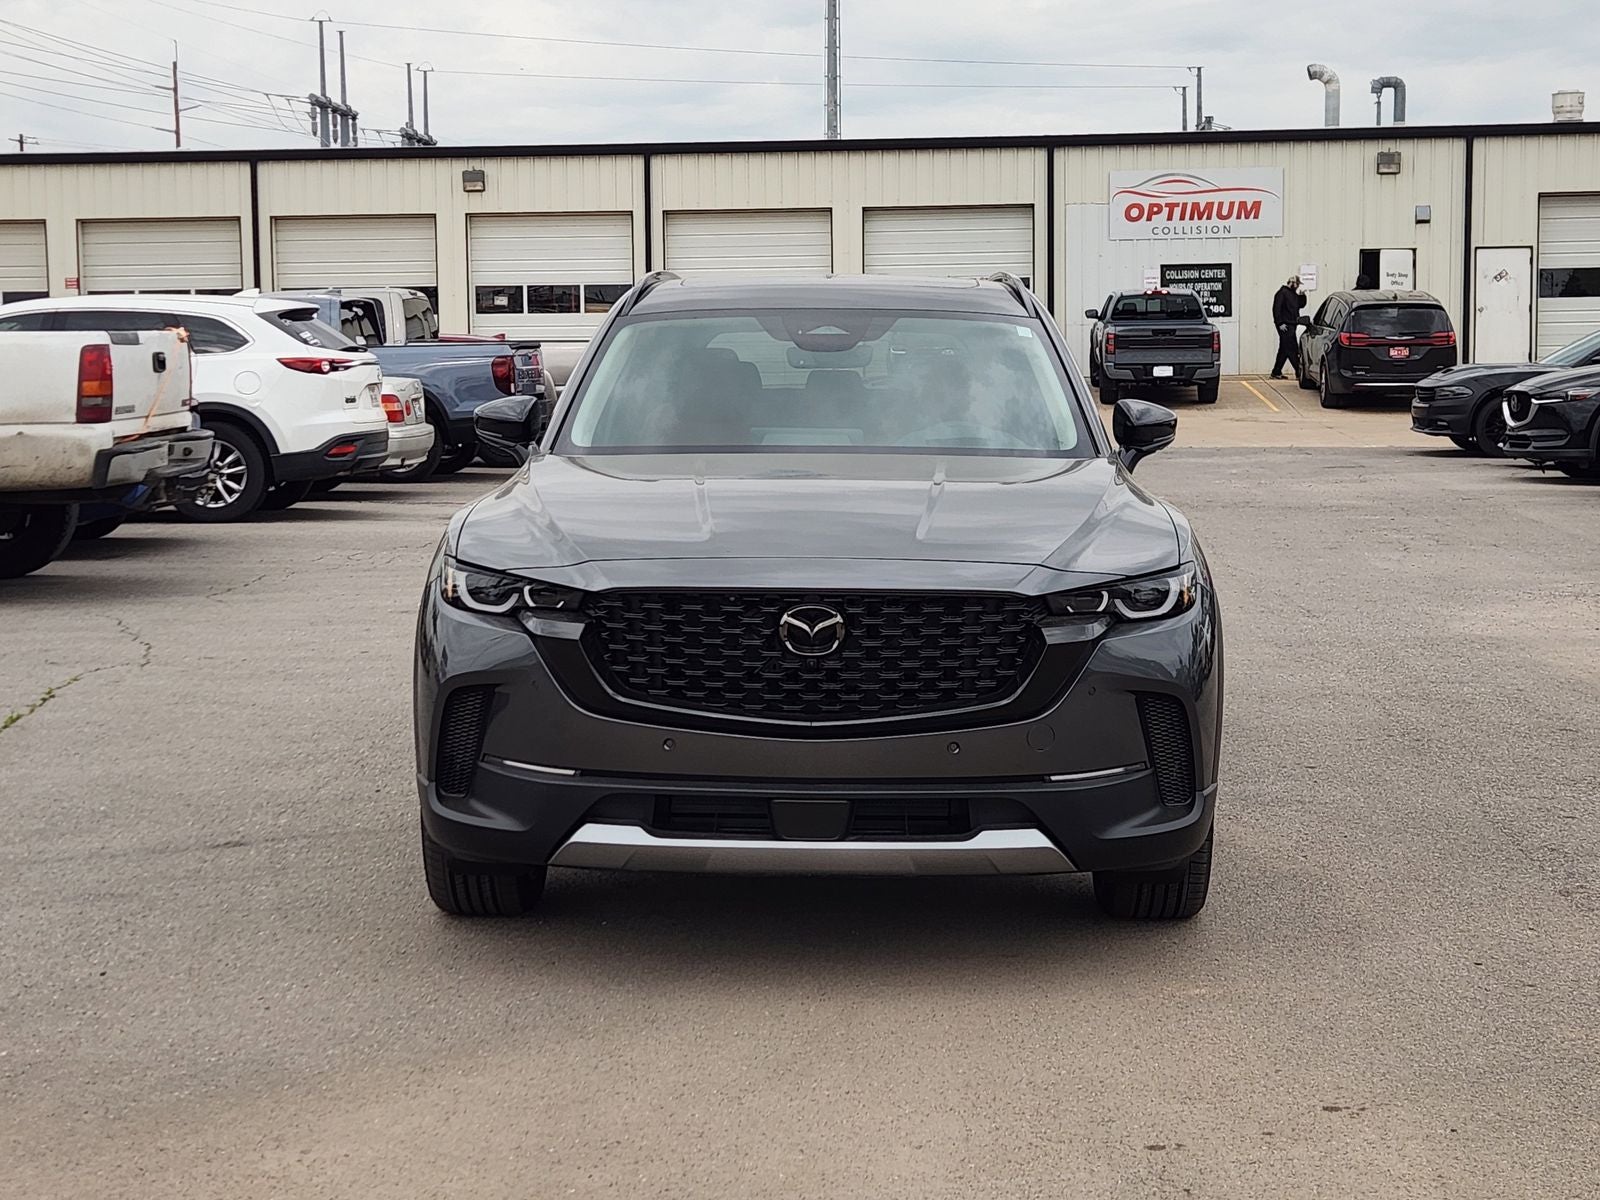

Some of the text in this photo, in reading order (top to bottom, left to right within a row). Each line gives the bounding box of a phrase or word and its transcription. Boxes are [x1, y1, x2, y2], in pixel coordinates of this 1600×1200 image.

[1124, 200, 1262, 222] OPTIMUM
[1151, 225, 1232, 236] COLLISION
[1165, 269, 1226, 279] COLLISION CENTER
[1194, 282, 1222, 291] OPERATION
